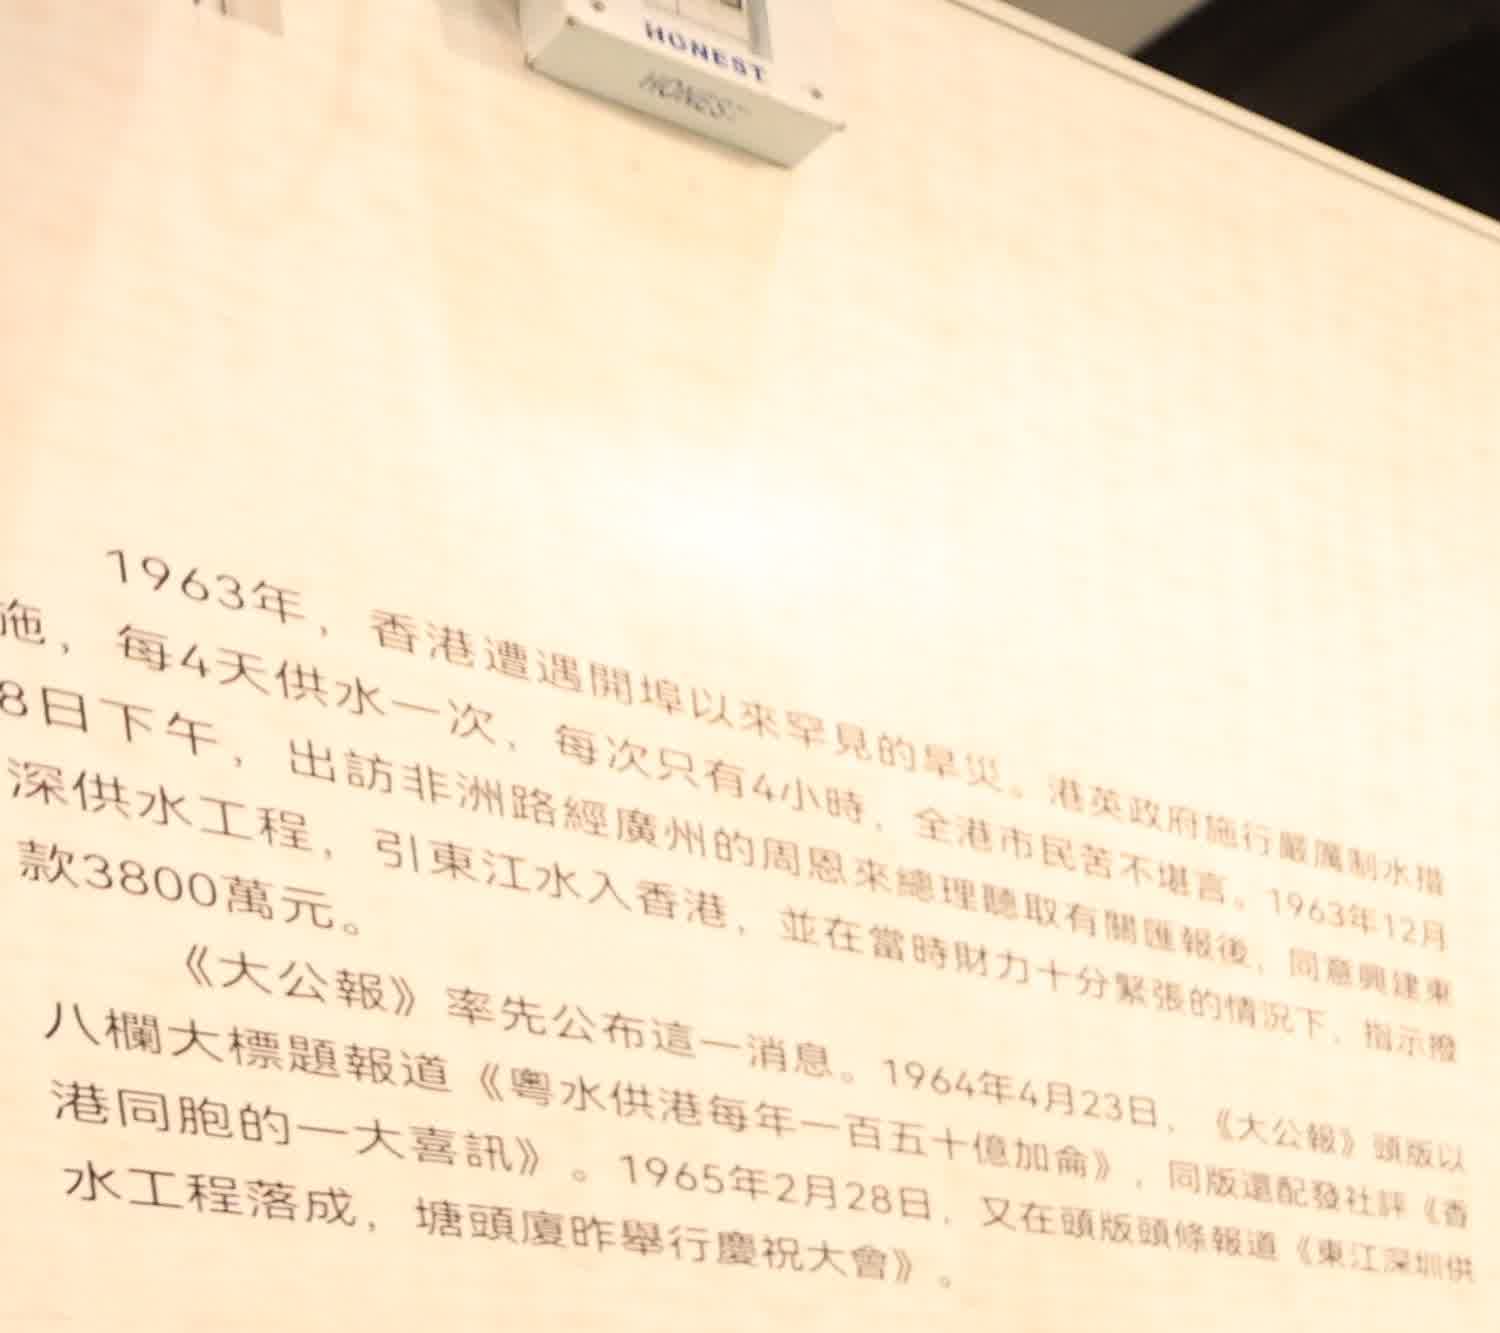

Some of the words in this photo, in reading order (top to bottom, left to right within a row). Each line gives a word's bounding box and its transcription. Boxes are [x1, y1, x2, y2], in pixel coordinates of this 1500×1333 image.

[644, 20, 767, 82] HONEST
[18, 838, 362, 937] 款3800萬元。
